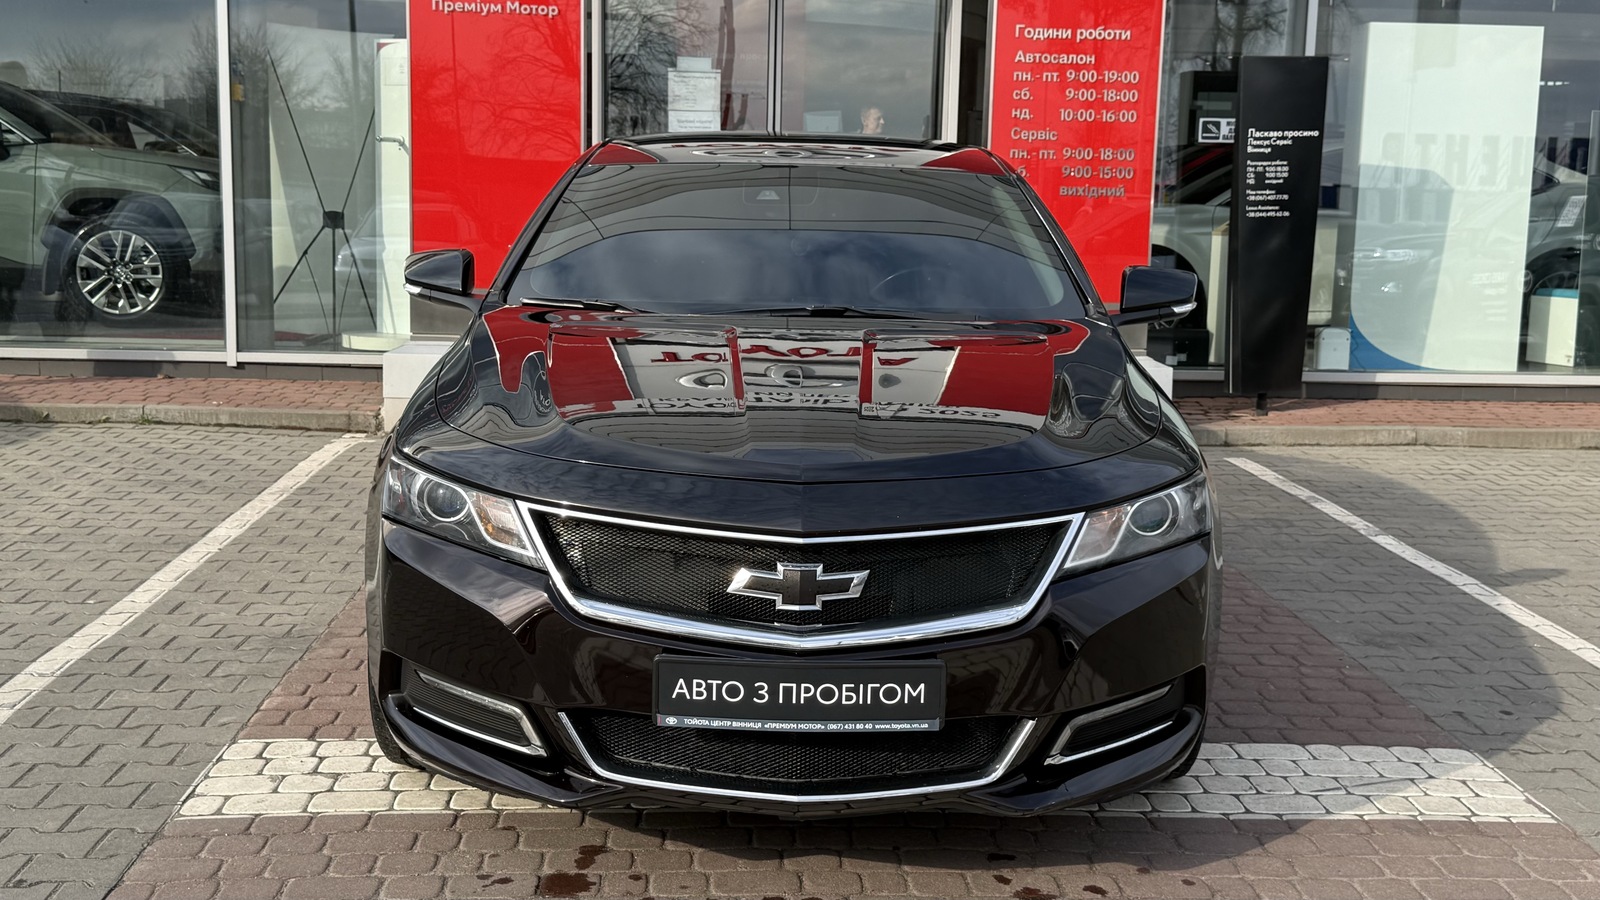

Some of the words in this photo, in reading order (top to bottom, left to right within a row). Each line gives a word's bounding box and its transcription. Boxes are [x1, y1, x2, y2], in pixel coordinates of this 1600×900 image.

[432, 0, 501, 15] Преміум
[506, 1, 559, 18] Мотор
[1015, 24, 1072, 40] Години
[1076, 26, 1131, 43] роботи
[1014, 50, 1096, 65] Автосалон
[1012, 87, 1034, 100] сб.
[1011, 108, 1034, 120] нд.
[1010, 127, 1058, 142] Сервіс
[1247, 128, 1283, 138] Ласкаво
[1283, 130, 1320, 139] просимо
[1015, 165, 1030, 178] б.
[1059, 184, 1125, 198] вихідний
[671, 678, 745, 703] АВТО
[753, 681, 769, 703] З
[778, 683, 925, 705] ПРОБІГОМ
[683, 718, 710, 726] ТОЙОТА
[711, 720, 732, 728] ЦЕНТР
[732, 721, 761, 729] ВІННИЦЯ
[874, 722, 929, 731] www.toyota.vn.ua
